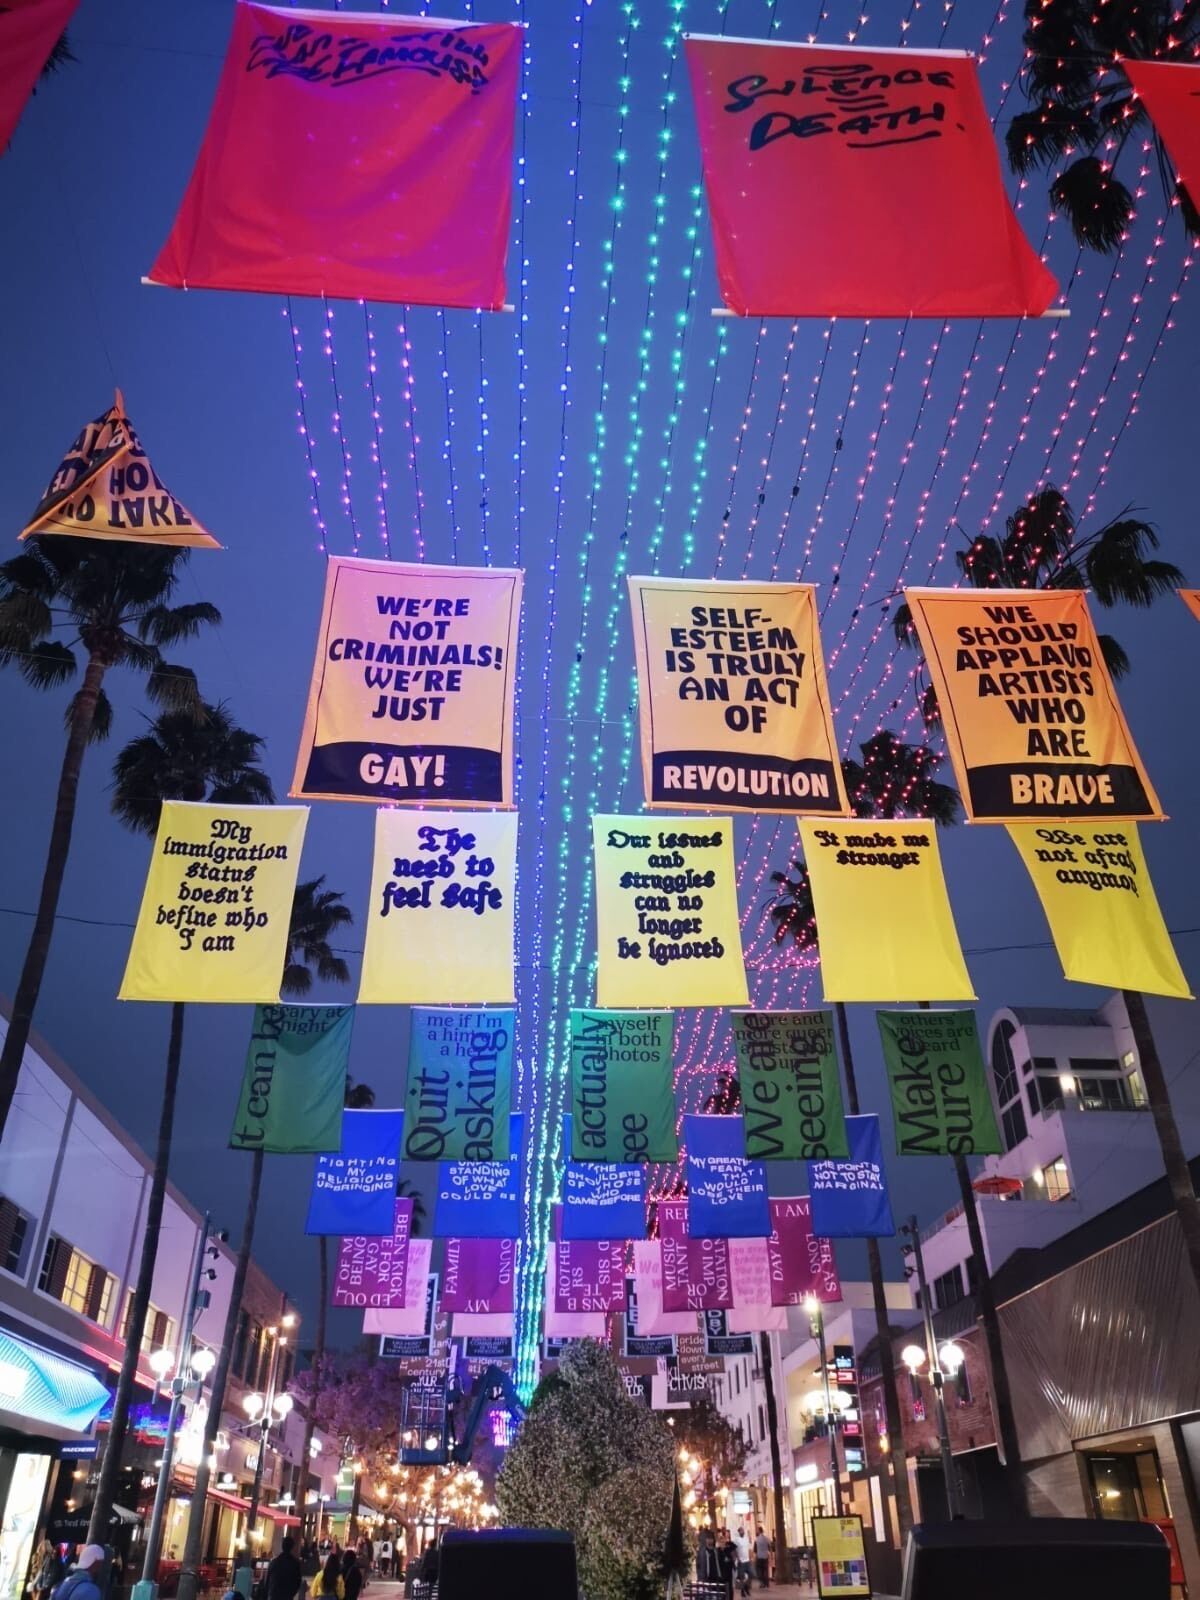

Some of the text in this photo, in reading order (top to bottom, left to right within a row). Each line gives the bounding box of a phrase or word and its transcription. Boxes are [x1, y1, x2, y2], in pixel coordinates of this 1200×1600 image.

[750, 103, 945, 150] DEATH
[376, 595, 470, 617] WE'RE
[983, 606, 1036, 624] WE
[691, 606, 772, 629] SELF-
[389, 620, 450, 641] NOT
[670, 627, 798, 651] ESTEEM
[957, 622, 1077, 646] SHOULD
[329, 638, 503, 670] CRIMINALS!
[665, 650, 805, 679] IS TRULY
[364, 666, 462, 692] WE'RE
[978, 669, 1094, 697] ARTISTS
[679, 676, 800, 708] AN ACT
[372, 695, 446, 721] JUST
[724, 705, 767, 733] OF
[1005, 698, 1085, 724] WHO
[1027, 729, 1090, 757] ARE
[359, 753, 446, 787] GAY!
[663, 765, 829, 798] REVOLUTION
[1010, 774, 1115, 805] BRAVE
[211, 819, 252, 844] My
[417, 826, 476, 856] The
[607, 830, 723, 848] Our issues
[814, 830, 930, 847] It made me
[1036, 829, 1128, 846] We are
[163, 836, 287, 864] immigration
[648, 851, 685, 868] and
[836, 850, 920, 869] stronger
[1035, 848, 1078, 863] not
[185, 862, 257, 882] status
[393, 854, 495, 878] need to
[619, 869, 715, 894] struggles
[178, 882, 253, 904] doesn't
[380, 880, 502, 917] feel safe
[635, 895, 703, 911] can no
[156, 905, 268, 932] define who
[638, 912, 702, 939] longer
[202, 934, 235, 951] am
[617, 937, 725, 965] be ignored
[280, 1019, 330, 1035] night
[427, 1013, 502, 1028] me if I'm
[792, 1012, 825, 1025] and
[427, 1030, 437, 1041] a
[618, 1032, 662, 1047] both
[946, 1026, 974, 1038] are
[440, 1045, 449, 1056] a
[248, 1051, 276, 1118] can
[573, 1012, 619, 1150] actually
[455, 1029, 508, 1163] asking
[787, 1034, 829, 1160] seeing
[894, 1033, 941, 1154] Make
[405, 1067, 456, 1161] Quit
[744, 1079, 784, 1160] We
[937, 1063, 975, 1155] sure
[622, 1112, 650, 1163] see
[320, 1156, 396, 1168] FIGHTING
[347, 1167, 366, 1176] MY
[449, 1165, 510, 1177] STANDING
[689, 1155, 706, 1169] MY
[710, 1164, 742, 1173] FEAR
[812, 1160, 834, 1172] THE
[837, 1161, 869, 1171] POINT
[317, 1172, 393, 1184] RELIGIOUS
[452, 1175, 507, 1188] OF WHAT
[568, 1179, 585, 1189] OF
[704, 1178, 748, 1192] WOULD
[722, 1168, 754, 1180] THAT
[814, 1169, 880, 1182] NOT TO STAY
[316, 1180, 393, 1192] UPBRINGING
[440, 1192, 492, 1201] COULD
[465, 1184, 497, 1194] LOVE
[727, 1184, 763, 1194] THEIR
[814, 1181, 884, 1190] MARGINAL
[567, 1194, 598, 1205] CAME
[711, 1192, 743, 1205] LOVE
[775, 1203, 810, 1217] I AM
[349, 1236, 367, 1285] BEING
[365, 1242, 379, 1274] GAY
[390, 1214, 408, 1298] BEEN KICK
[611, 1247, 622, 1272] MY
[663, 1237, 677, 1290] MUSIC
[805, 1233, 821, 1274] LONG
[339, 1259, 350, 1280] OF
[378, 1251, 392, 1283] FOR
[445, 1237, 461, 1295] FAMILY
[770, 1249, 784, 1281] DAY
[822, 1270, 837, 1292] AS
[464, 1299, 490, 1312] MY
[407, 1367, 446, 1379] century
[691, 1361, 719, 1372] street
